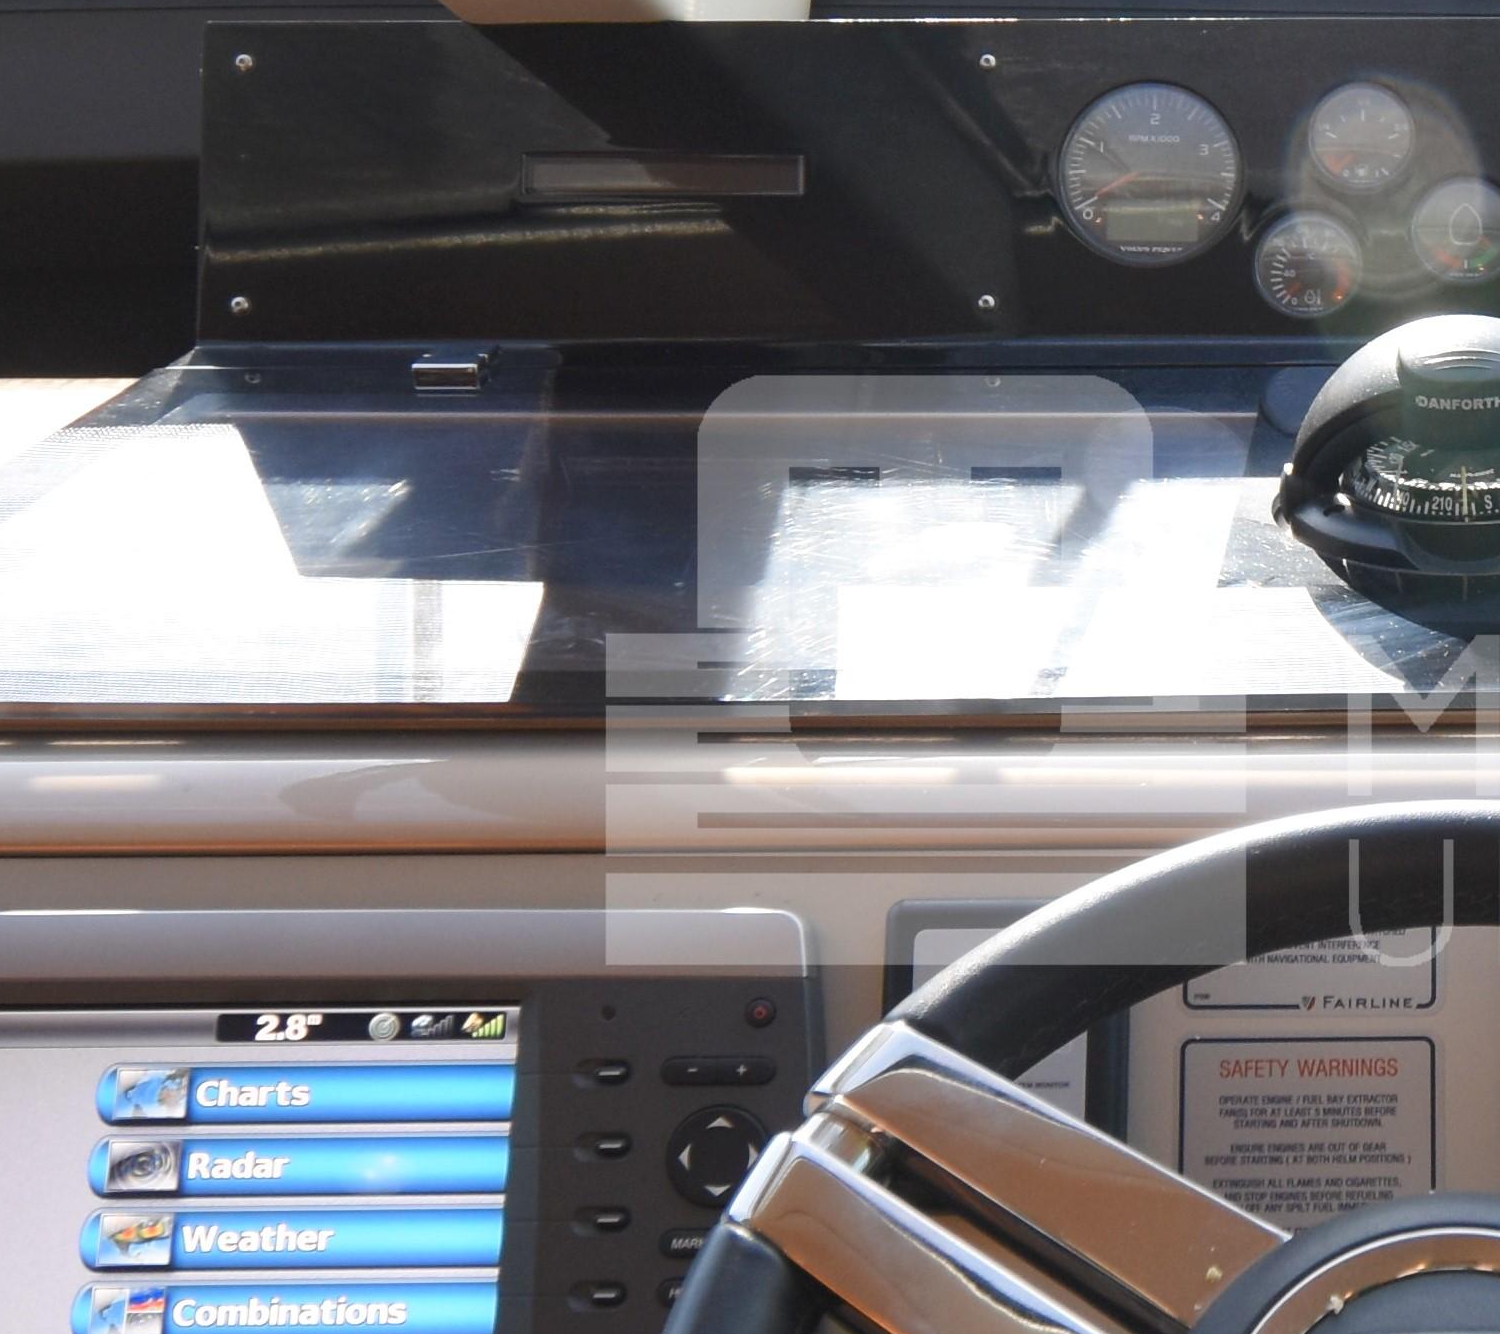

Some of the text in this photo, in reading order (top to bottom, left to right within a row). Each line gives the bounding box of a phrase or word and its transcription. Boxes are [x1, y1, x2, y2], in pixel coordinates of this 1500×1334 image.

[1200, 144, 1209, 156] 3
[1432, 497, 1453, 512] 210
[1484, 496, 1493, 509] S
[1266, 953, 1381, 964] NAVIGATIONAL EQUIPMENT
[1323, 996, 1413, 1009] FAIRLINE
[1219, 1058, 1399, 1079] SAFETY WARNINGS
[196, 1079, 311, 1107] Charts
[1219, 1095, 1259, 1105] OPERATE
[1262, 1095, 1292, 1105] ENGINE
[1303, 1095, 1322, 1104] FUEL
[1327, 1095, 1344, 1104] BAY
[1347, 1094, 1398, 1104] EXTRACTOR
[1250, 1108, 1267, 1117] FOR
[1270, 1107, 1282, 1117] AT
[1284, 1107, 1312, 1116] LEAST
[1322, 1107, 1361, 1116] MINUTES
[1364, 1106, 1396, 1116] BEFORE
[1234, 1119, 1277, 1128] STARTING
[1279, 1119, 1298, 1128] AND
[1301, 1119, 1328, 1128] AFTER
[1230, 1142, 1386, 1153] ENSURE ENGINES ARE OUT OF GEAR
[187, 1151, 289, 1180] Radar
[1205, 1156, 1236, 1165] BEFORE
[1240, 1155, 1284, 1165] STARTING
[1292, 1155, 1304, 1164] AT
[1307, 1155, 1330, 1164] BOTH
[1332, 1154, 1357, 1164] HELM
[1359, 1154, 1405, 1163] POSITIONS
[1213, 1179, 1265, 1189] EXTINGUISH
[1267, 1179, 1282, 1188] ALL
[1287, 1179, 1321, 1188] FLAMES
[1325, 1178, 1343, 1188] AND
[1224, 1190, 1394, 1202] AND STOP ENGINES BEFORE REFUELING
[1264, 1203, 1284, 1212] ANY
[1287, 1203, 1311, 1213] SPILT
[1313, 1202, 1334, 1212] FUEL
[181, 1223, 334, 1253] Weather
[172, 1297, 407, 1328] Combinations
